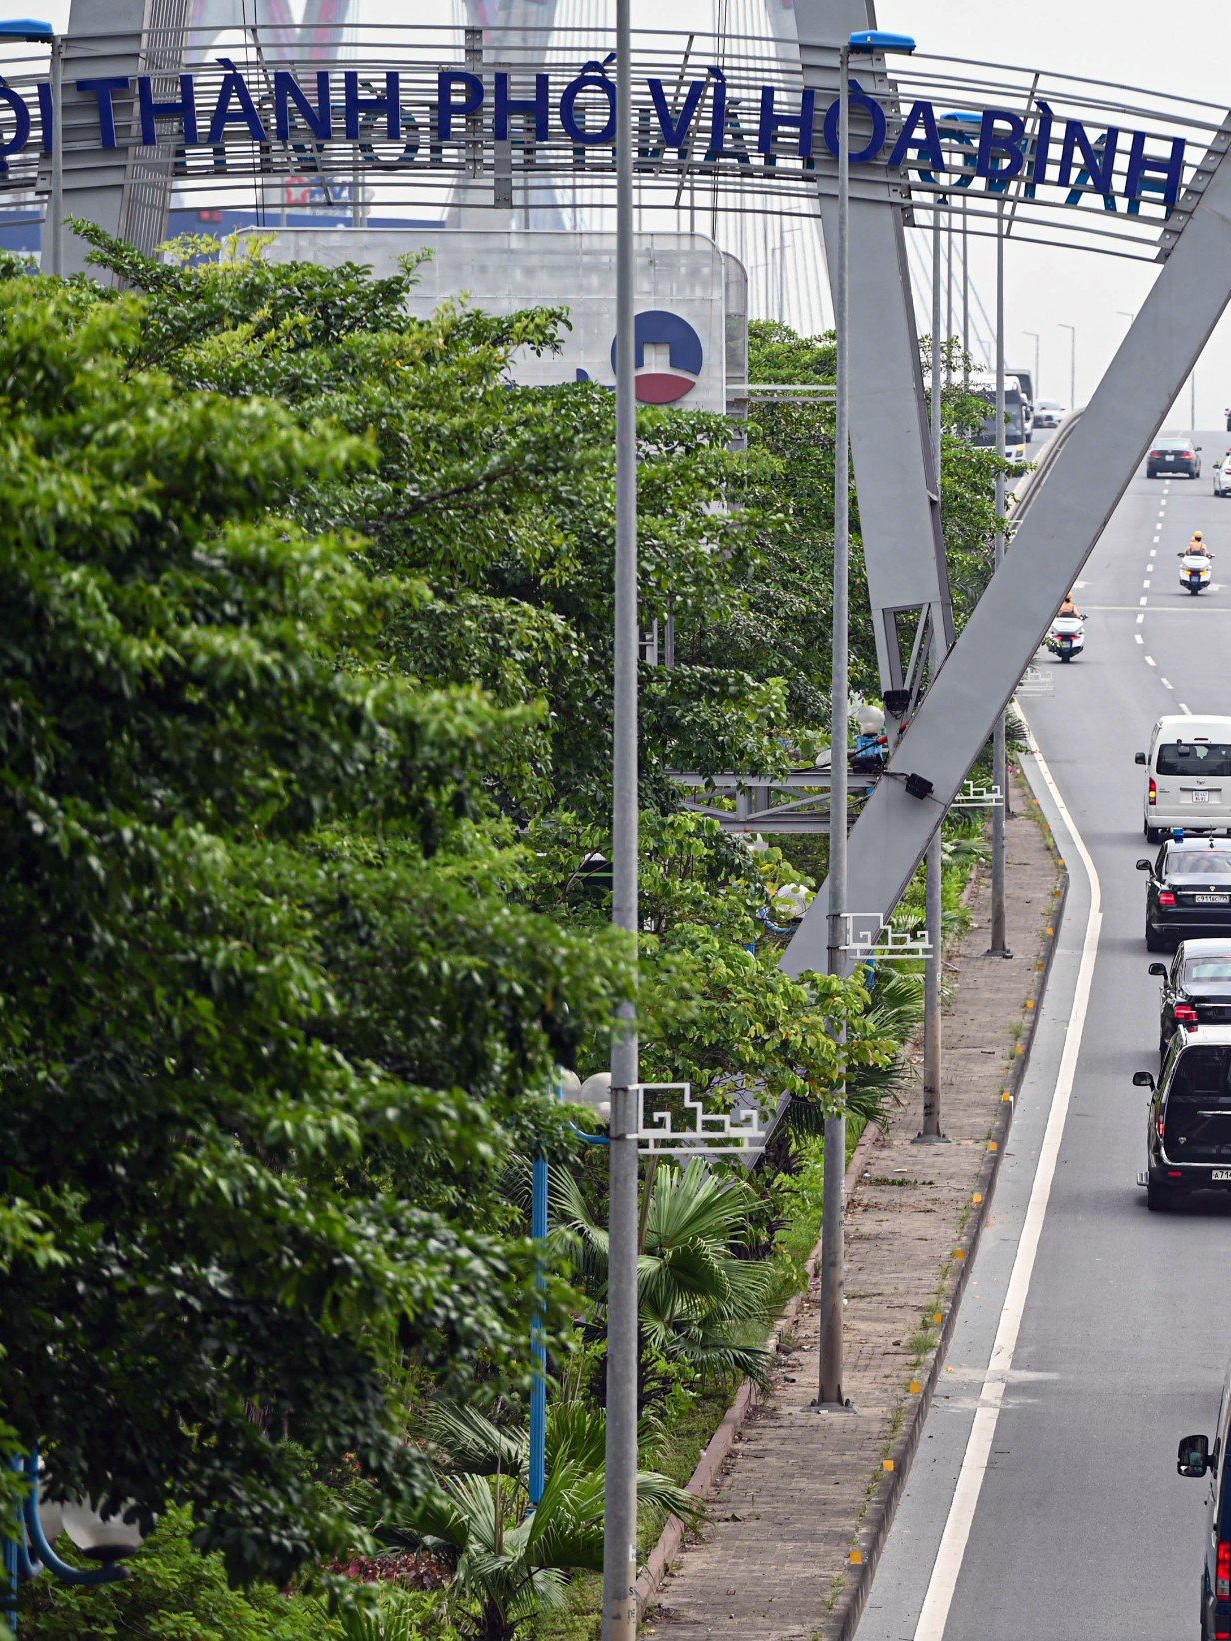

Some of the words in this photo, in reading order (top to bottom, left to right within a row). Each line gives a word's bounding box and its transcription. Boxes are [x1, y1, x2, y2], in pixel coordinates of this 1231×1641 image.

[76, 58, 400, 149] THÀNH
[437, 53, 618, 146] PHỐ
[647, 66, 728, 152] VÌ
[758, 79, 945, 171] HÒA
[975, 100, 1187, 205] BÌNH
